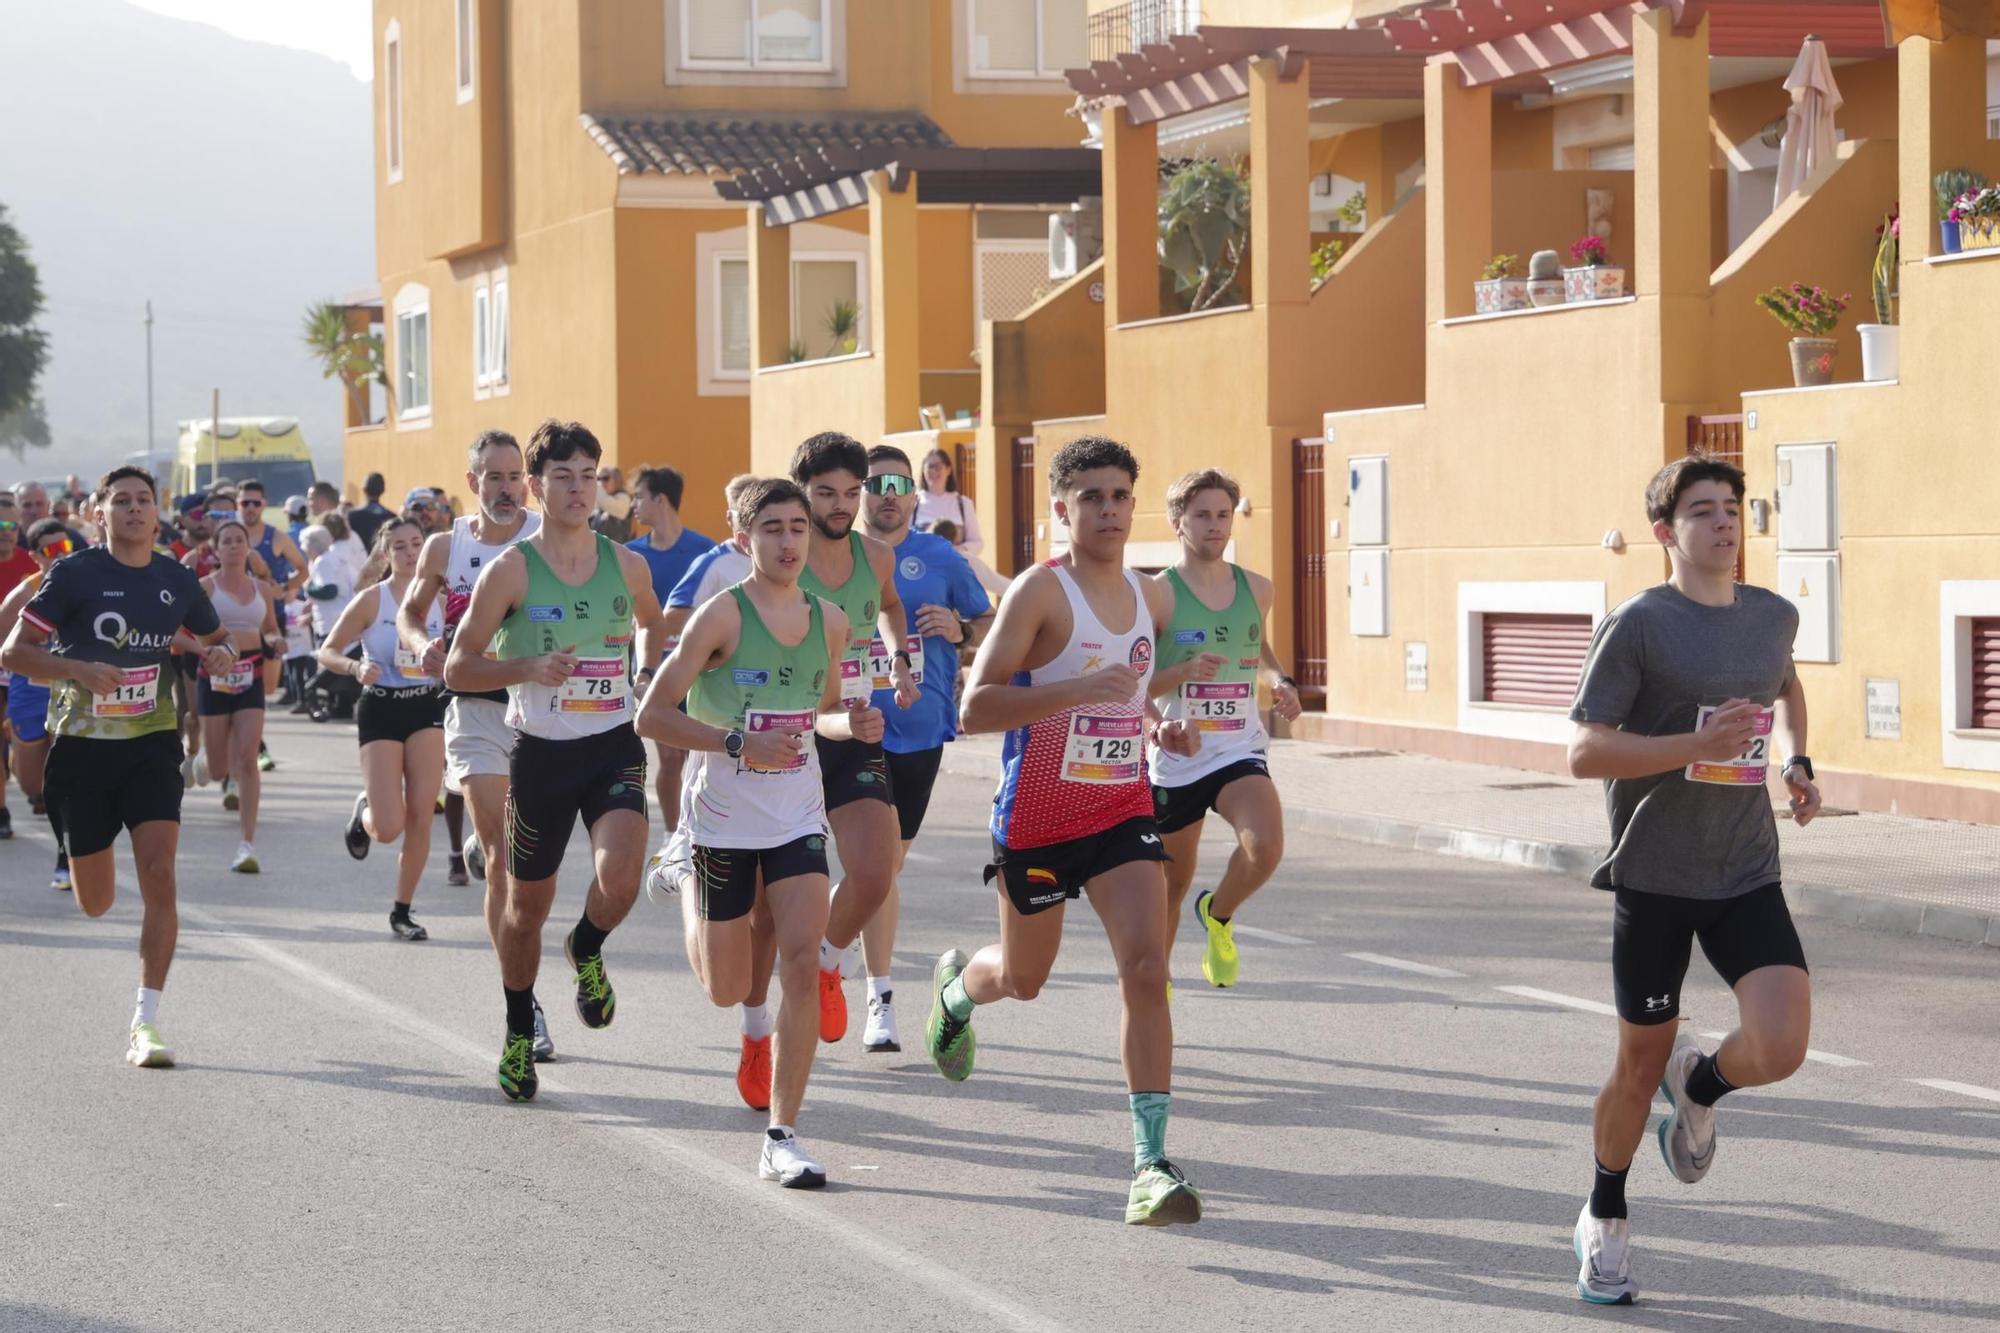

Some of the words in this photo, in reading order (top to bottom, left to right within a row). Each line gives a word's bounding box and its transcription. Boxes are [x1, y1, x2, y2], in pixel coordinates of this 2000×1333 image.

[114, 685, 146, 700] 114
[586, 679, 612, 695] 78
[1202, 700, 1236, 716] 135
[1092, 739, 1132, 759] 129
